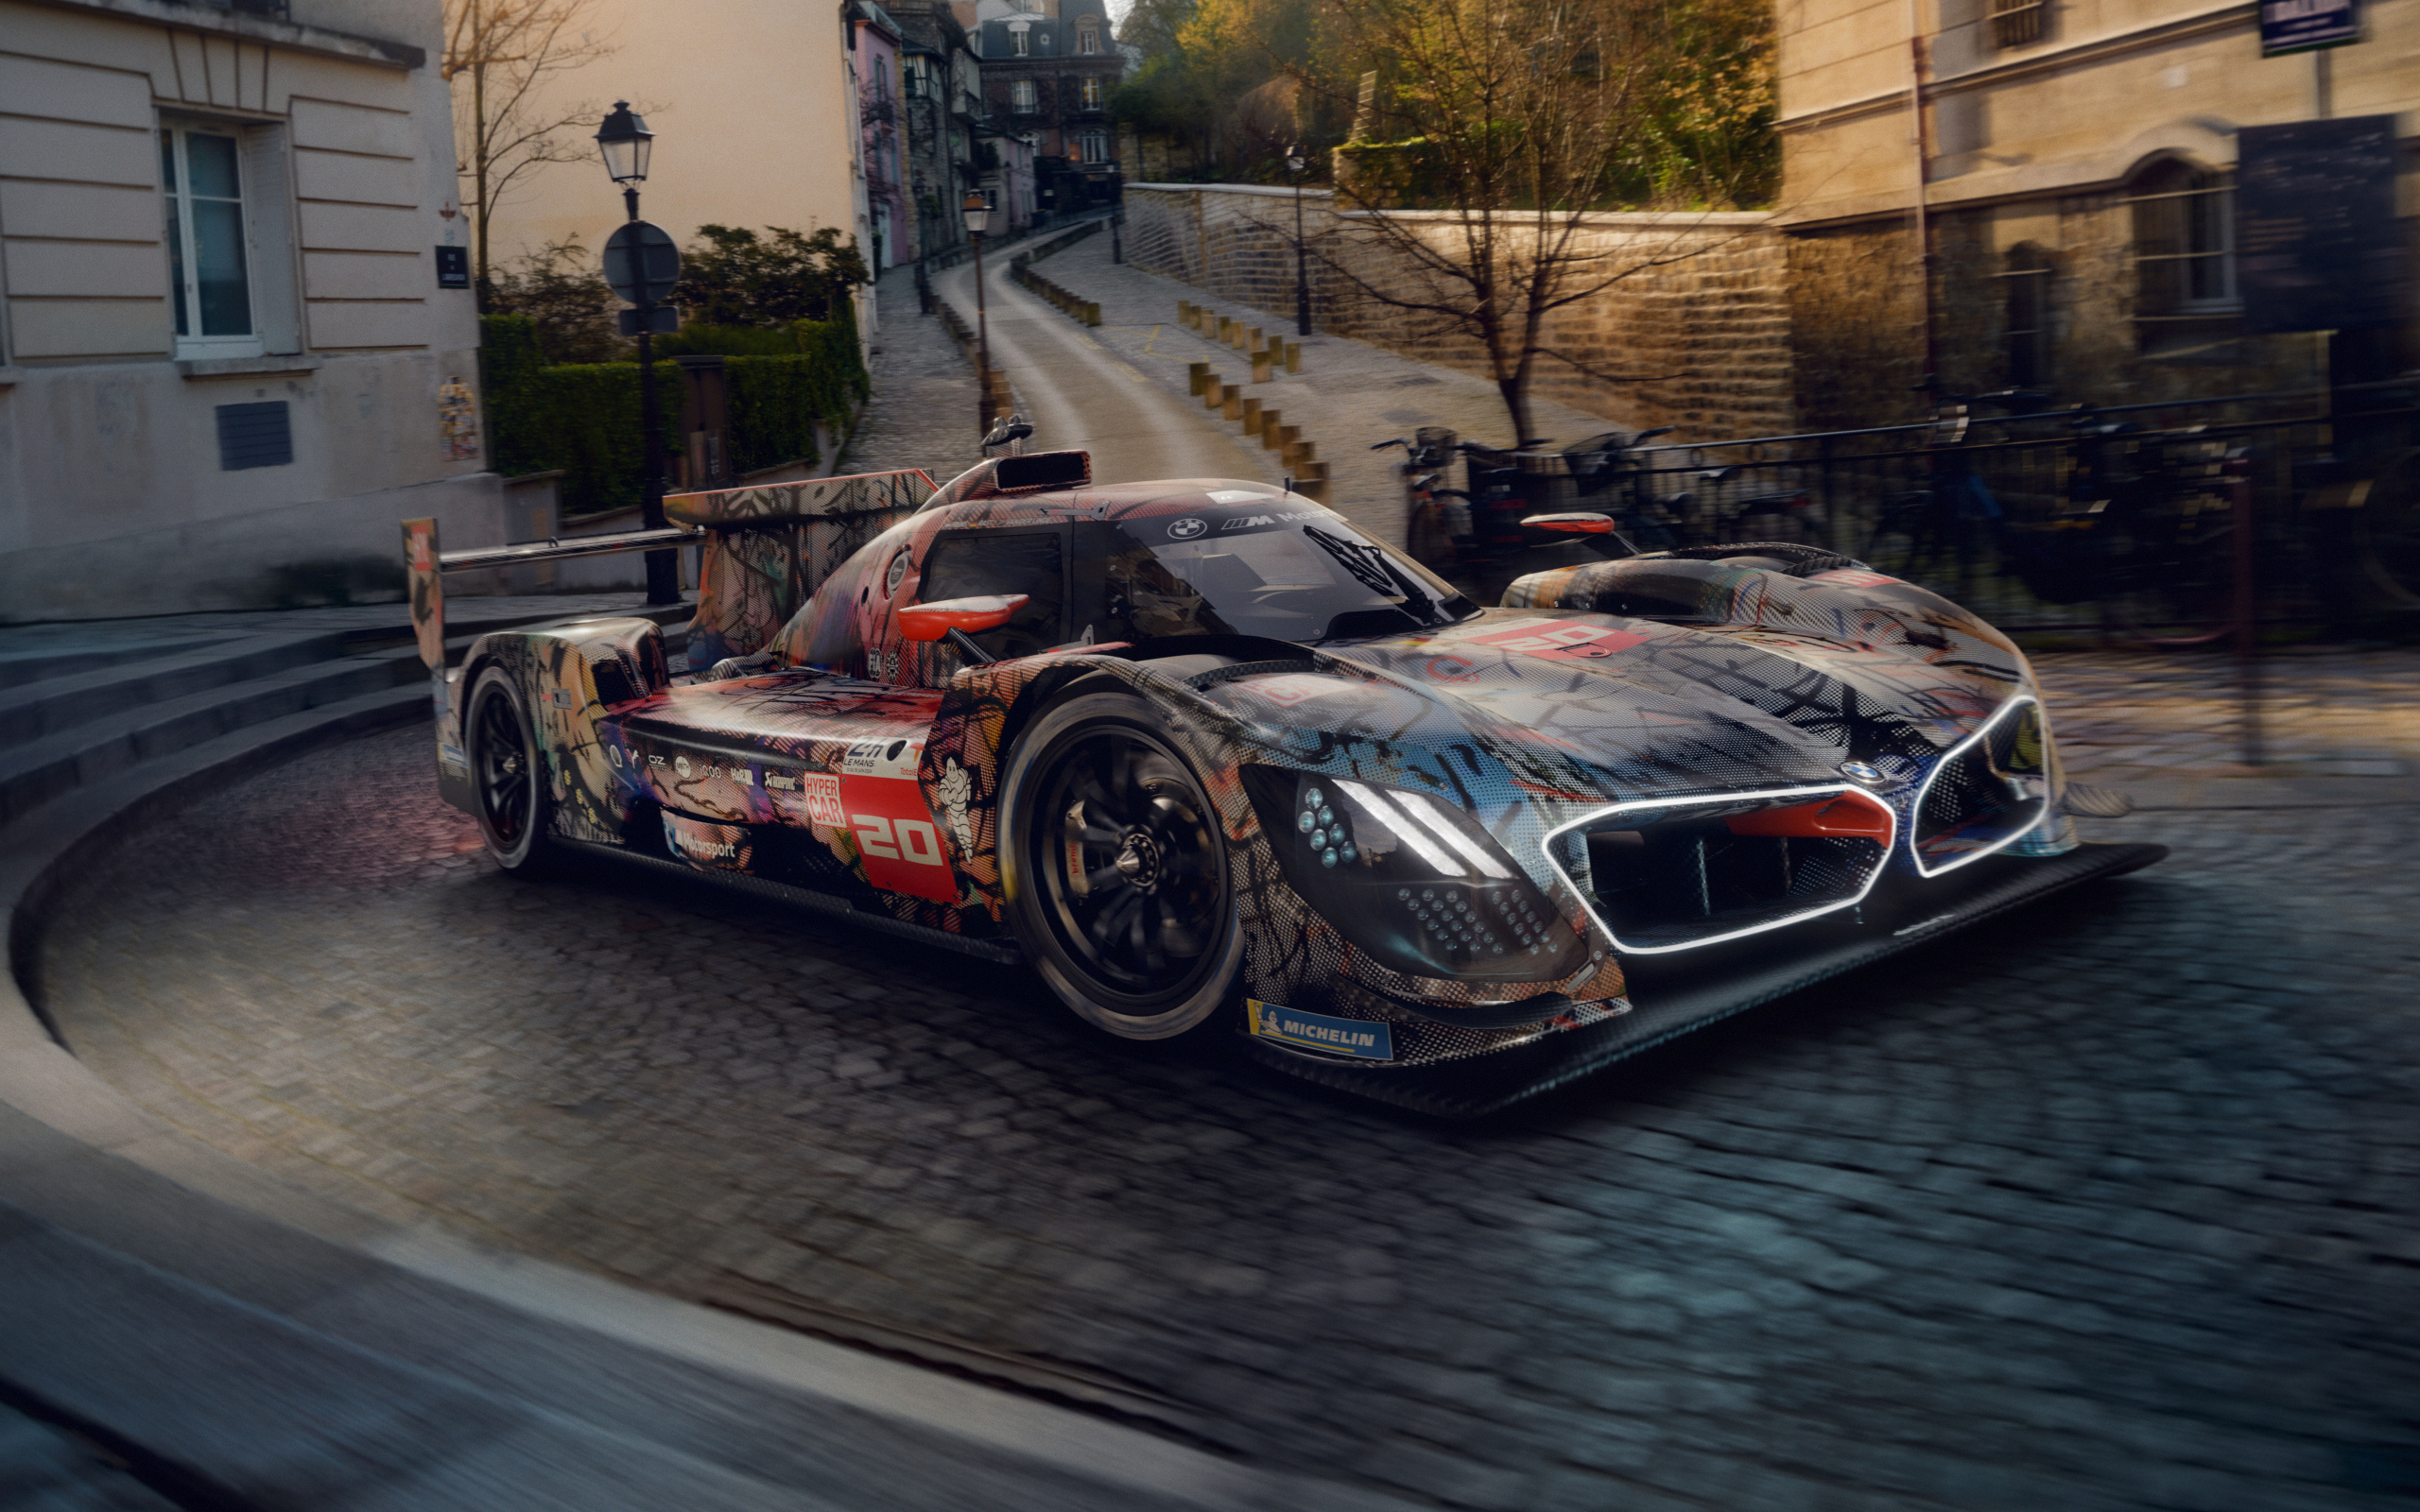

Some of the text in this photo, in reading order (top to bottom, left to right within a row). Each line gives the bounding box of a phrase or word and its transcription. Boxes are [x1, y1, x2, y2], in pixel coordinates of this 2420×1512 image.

[1487, 625, 1616, 652] 20
[648, 755, 666, 765] OZ
[853, 759, 875, 767] MANS
[806, 777, 838, 797] HYPER
[808, 795, 844, 824] CAR
[683, 832, 735, 859] Motorsport
[852, 814, 943, 867] 20
[1069, 839, 1080, 874] bremb
[1283, 1020, 1375, 1047] MICHELIN
